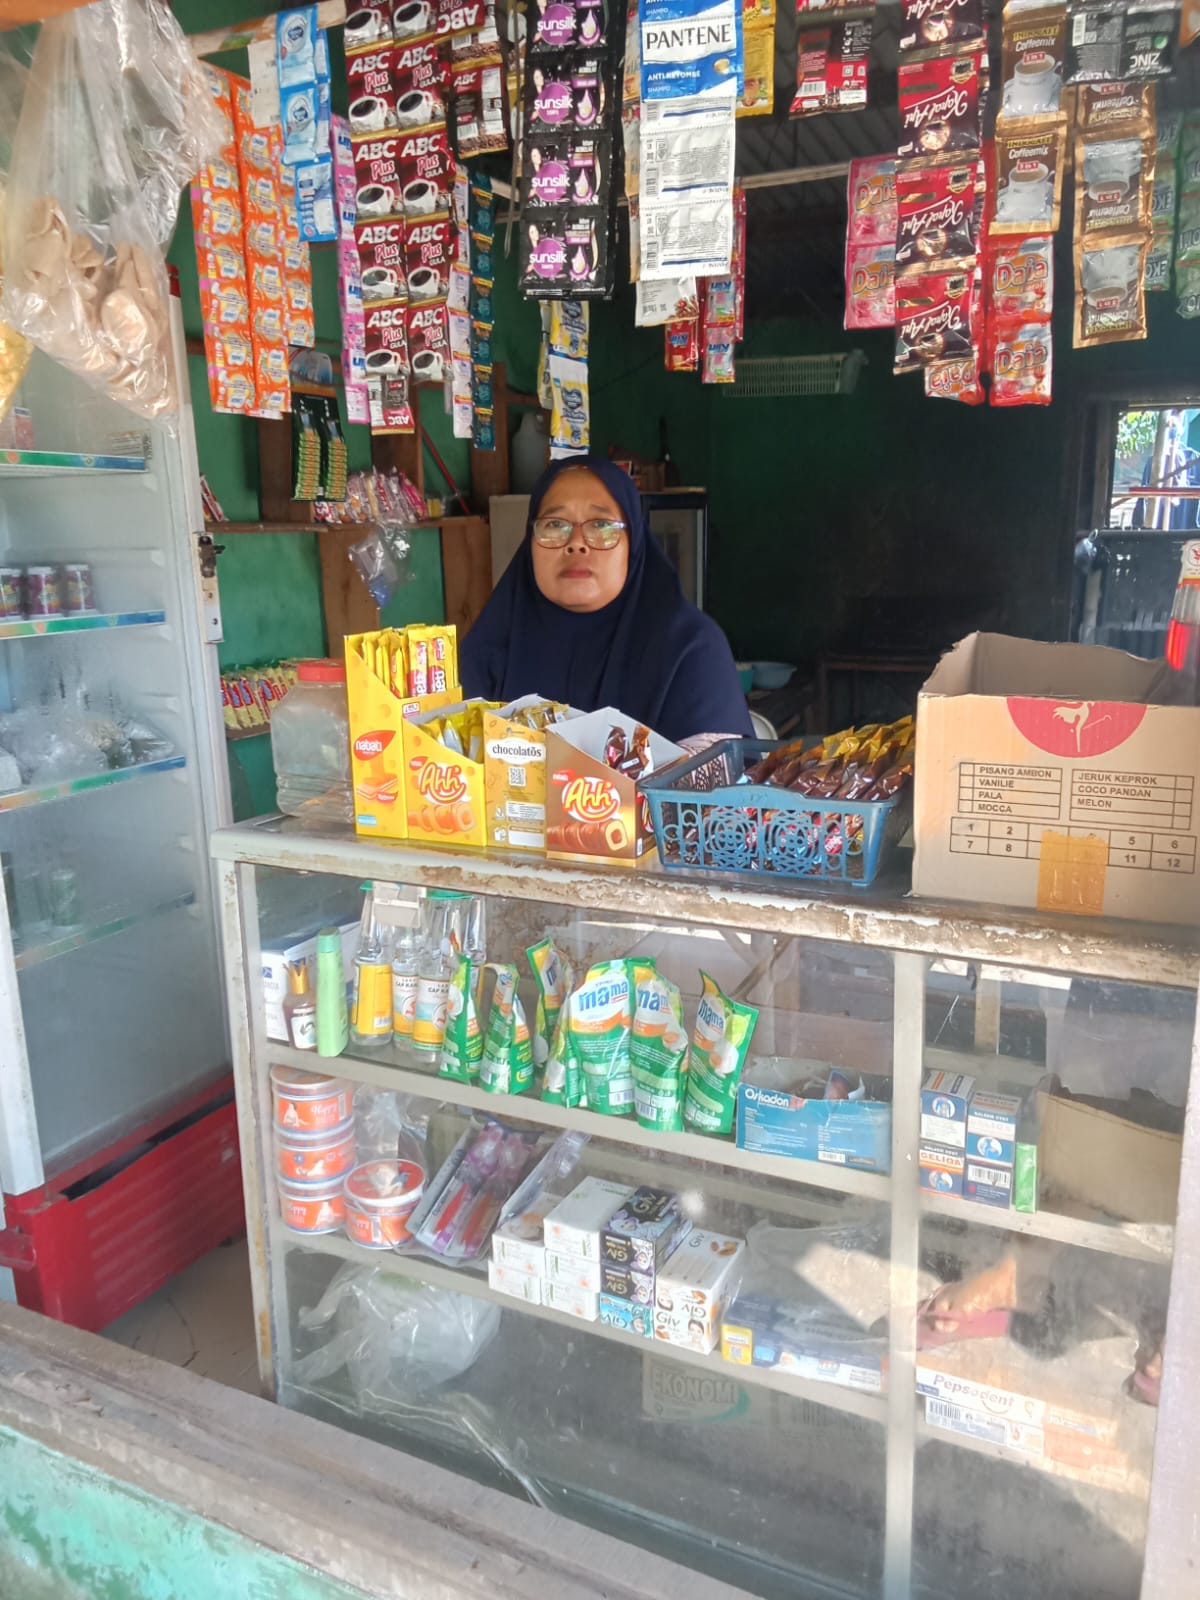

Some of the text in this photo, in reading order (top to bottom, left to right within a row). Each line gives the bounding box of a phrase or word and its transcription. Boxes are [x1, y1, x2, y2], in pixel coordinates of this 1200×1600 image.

[436, 4, 479, 34] ABC
[537, 16, 577, 32] sunsilk
[646, 23, 732, 50] PANTENE
[1015, 36, 1056, 53] Coffeemix
[350, 52, 391, 75] ABC
[398, 42, 437, 69] ABC
[1129, 51, 1161, 70] ZINC
[364, 71, 389, 95] Plus
[412, 64, 433, 87] Plus
[453, 72, 478, 88] ABC
[533, 96, 574, 111] sunsilk
[903, 90, 969, 128] Kapal Api
[355, 139, 397, 162] ABC
[401, 133, 442, 158] ABC
[1009, 144, 1050, 161] Coffeemix
[370, 160, 395, 182] Plus
[416, 154, 440, 178] Plus
[531, 174, 571, 189] sunsilk
[901, 199, 964, 236] Kapal Api
[359, 223, 400, 245] ABC
[408, 222, 447, 245] ABC
[374, 243, 398, 264] Plus
[421, 242, 443, 263] Plus
[528, 251, 568, 265] sunsilk
[995, 257, 1048, 293] Daia
[367, 308, 404, 329] ABC
[410, 307, 447, 329] ABC
[382, 326, 403, 349] Plus
[425, 326, 443, 347] Plus
[707, 342, 730, 354] Klin
[995, 342, 1047, 378] Daia
[929, 363, 975, 393] Daia
[388, 415, 411, 426] ABC
[979, 766, 1052, 779] PISANG AMBON
[1078, 773, 1157, 786] JERUK KEPROK
[421, 763, 466, 805] Ahh
[979, 778, 1014, 789] VANILIE
[1078, 785, 1152, 798] COCO PANDAN
[566, 777, 616, 820] Ahh
[978, 791, 1003, 801] PALA
[1077, 798, 1112, 809] MELON
[978, 803, 1013, 814] MOCCA
[1006, 825, 1013, 835] 2
[1128, 836, 1136, 846] 5
[1171, 839, 1178, 849] 6
[967, 840, 1181, 868] 7 8 11 12
[578, 979, 629, 1012] mama
[697, 998, 724, 1029] mama
[744, 1088, 790, 1108] Oskadon
[632, 1192, 657, 1214] Giv
[688, 1232, 705, 1248] Giv
[606, 1247, 629, 1262] Giv
[605, 1280, 628, 1296] Giv
[602, 1313, 628, 1329] Giv
[655, 1311, 681, 1328] Giv
[680, 1302, 707, 1319] Giv
[650, 1366, 737, 1404] EKONOMI
[932, 1373, 1016, 1408] Pepsodent
